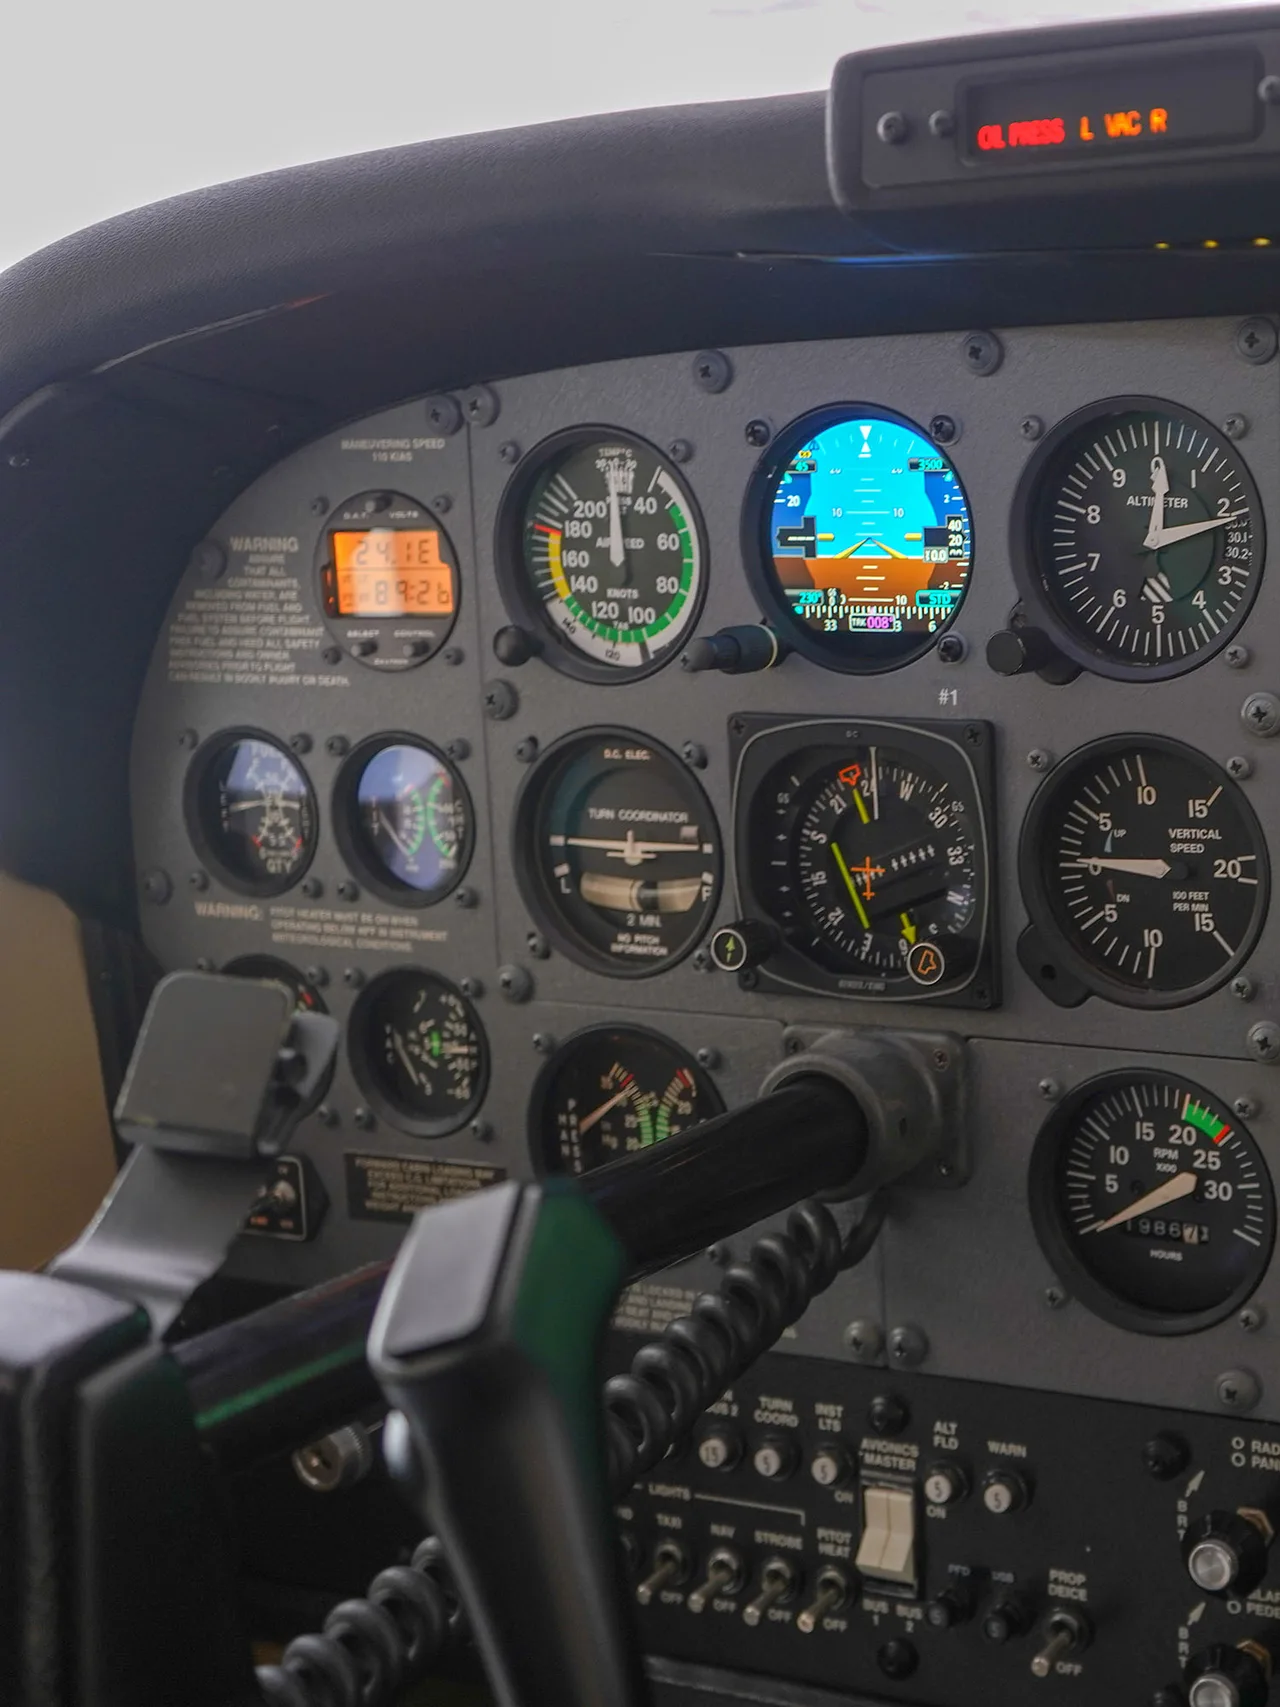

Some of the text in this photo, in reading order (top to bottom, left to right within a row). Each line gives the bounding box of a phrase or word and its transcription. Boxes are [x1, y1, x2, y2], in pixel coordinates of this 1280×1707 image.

[1104, 110, 1142, 137] VAC
[1150, 108, 1168, 133] R
[412, 437, 445, 450] SPEED
[918, 459, 943, 469] 3500
[574, 501, 607, 518] 200
[634, 497, 657, 514] 40
[565, 520, 592, 538] 180
[230, 536, 299, 552] WARNING
[657, 533, 680, 551] 60
[562, 550, 590, 568] 160
[571, 576, 598, 593] 140
[656, 576, 679, 593] 80
[607, 589, 639, 599] KNOTS
[929, 593, 951, 604] STD
[592, 601, 619, 619] 120
[628, 606, 656, 624] 100
[938, 688, 958, 706] #1
[1137, 786, 1157, 805] 10
[588, 807, 689, 823] TURN COORDINATOR
[1188, 799, 1209, 819] 15
[1169, 828, 1222, 840] VERTICAL
[1170, 843, 1205, 854] SPEED
[1213, 859, 1242, 878] 20
[1173, 902, 1209, 912] PER MIN
[1169, 1125, 1197, 1145] 20
[1153, 1147, 1179, 1160] RPM
[1193, 1149, 1222, 1170] 25
[1204, 1180, 1233, 1201] 30
[1150, 1249, 1183, 1261] HOURS
[753, 1409, 799, 1428] COORD
[815, 1402, 844, 1418] INST
[933, 1420, 957, 1436] ALT
[861, 1437, 919, 1458] AVIONICS
[933, 1435, 958, 1451] FLD
[987, 1440, 1027, 1458] WARN
[863, 1452, 916, 1472] MASTER
[649, 1483, 691, 1501] LIGHTS
[754, 1530, 803, 1550] STROBE
[817, 1526, 853, 1544] PITOT
[1049, 1569, 1086, 1586] PROP
[1048, 1584, 1088, 1602] DEICE
[822, 1617, 848, 1632] OFF
[1055, 1660, 1083, 1676] OFF
